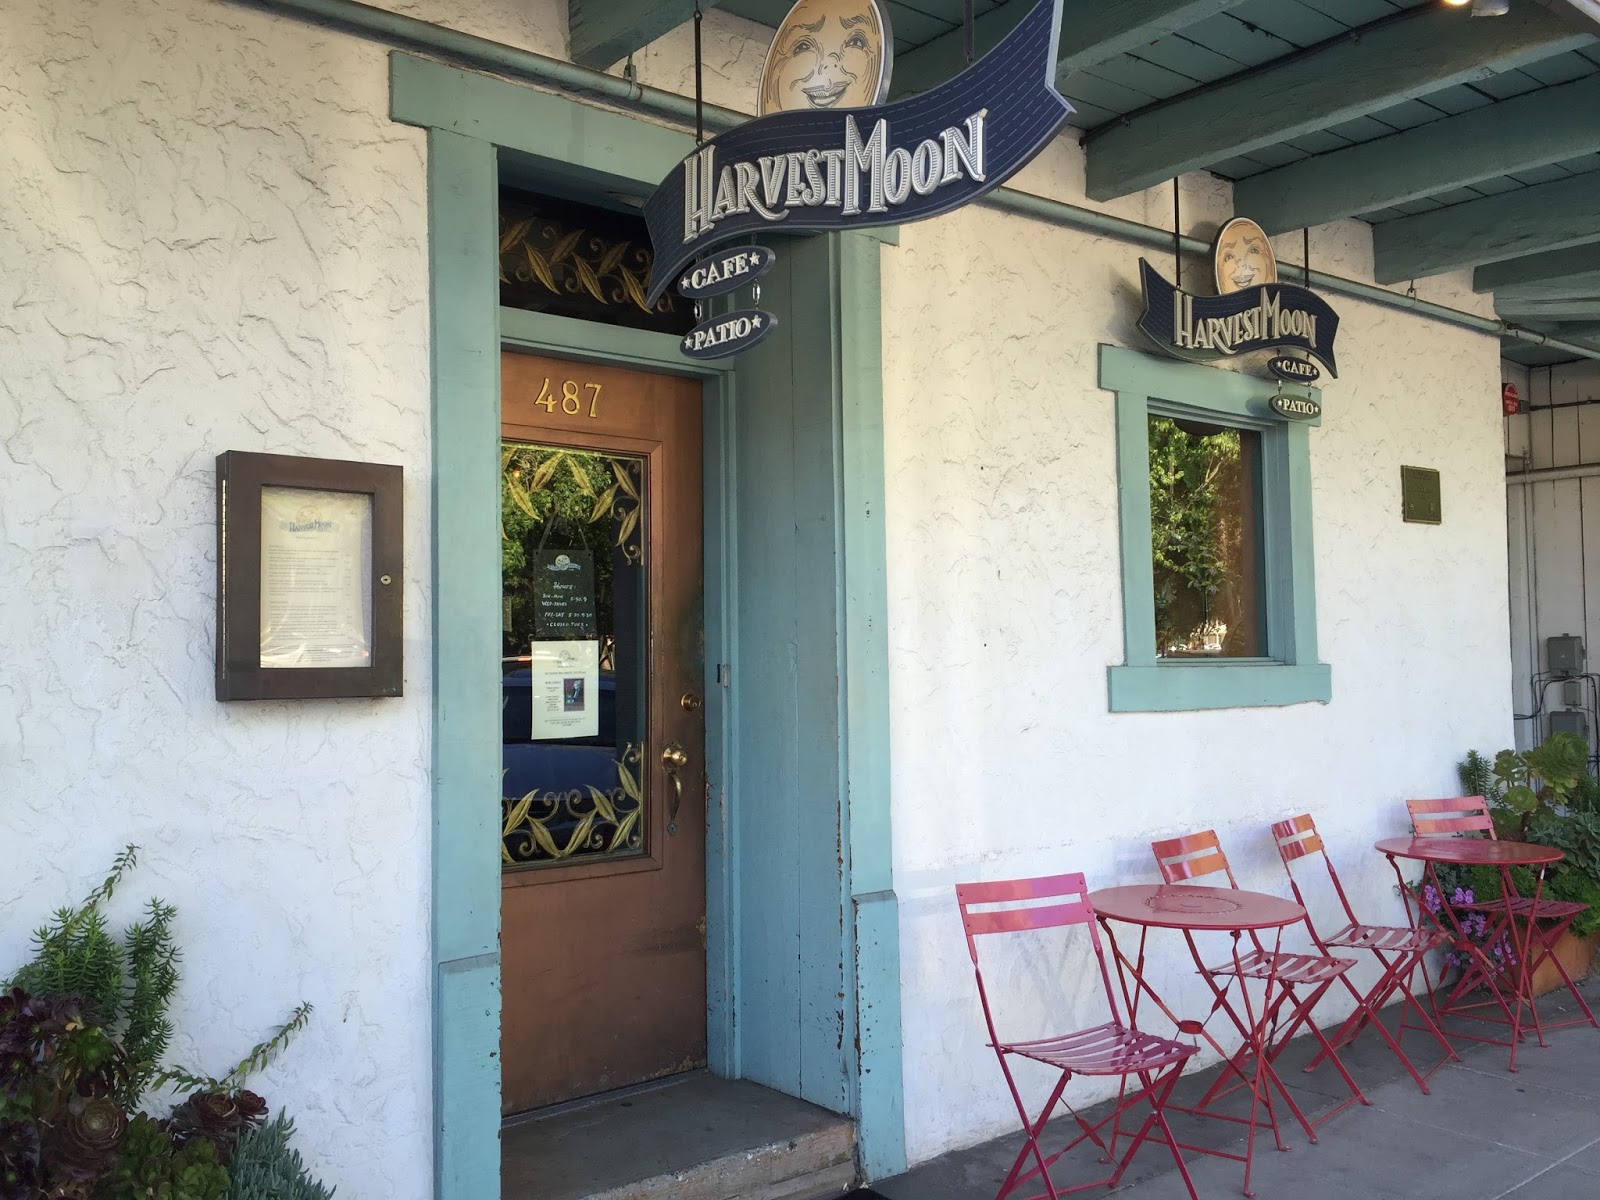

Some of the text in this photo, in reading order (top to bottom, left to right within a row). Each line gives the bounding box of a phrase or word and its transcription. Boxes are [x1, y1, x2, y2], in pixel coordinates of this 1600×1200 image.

[690, 252, 750, 290] CAFE
[694, 317, 753, 352] PATIO
[1282, 359, 1313, 377] CAFE
[534, 377, 603, 419] 487
[1282, 398, 1315, 415] PATIO
